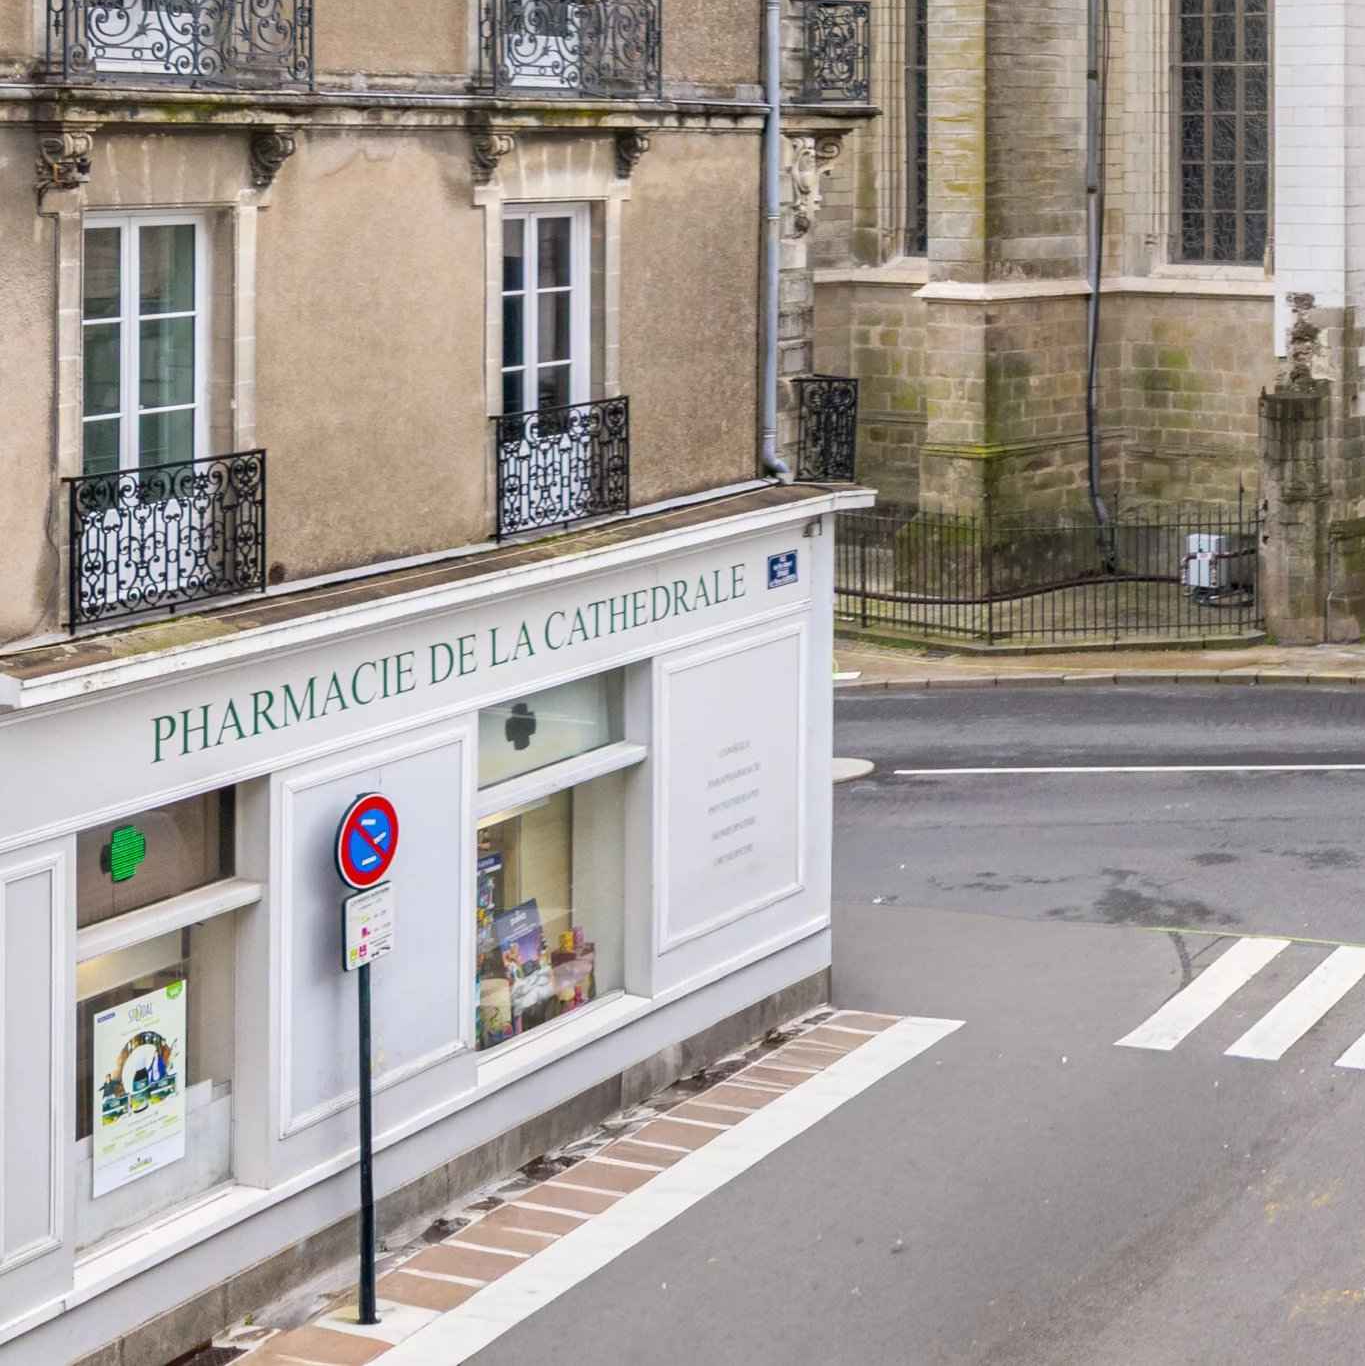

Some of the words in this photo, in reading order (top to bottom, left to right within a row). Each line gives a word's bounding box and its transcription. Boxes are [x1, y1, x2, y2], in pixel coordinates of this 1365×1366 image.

[151, 650, 417, 763] PHARMACIE
[430, 633, 477, 685] DE
[489, 620, 535, 668] LA
[544, 562, 747, 650] CATHEDRALE
